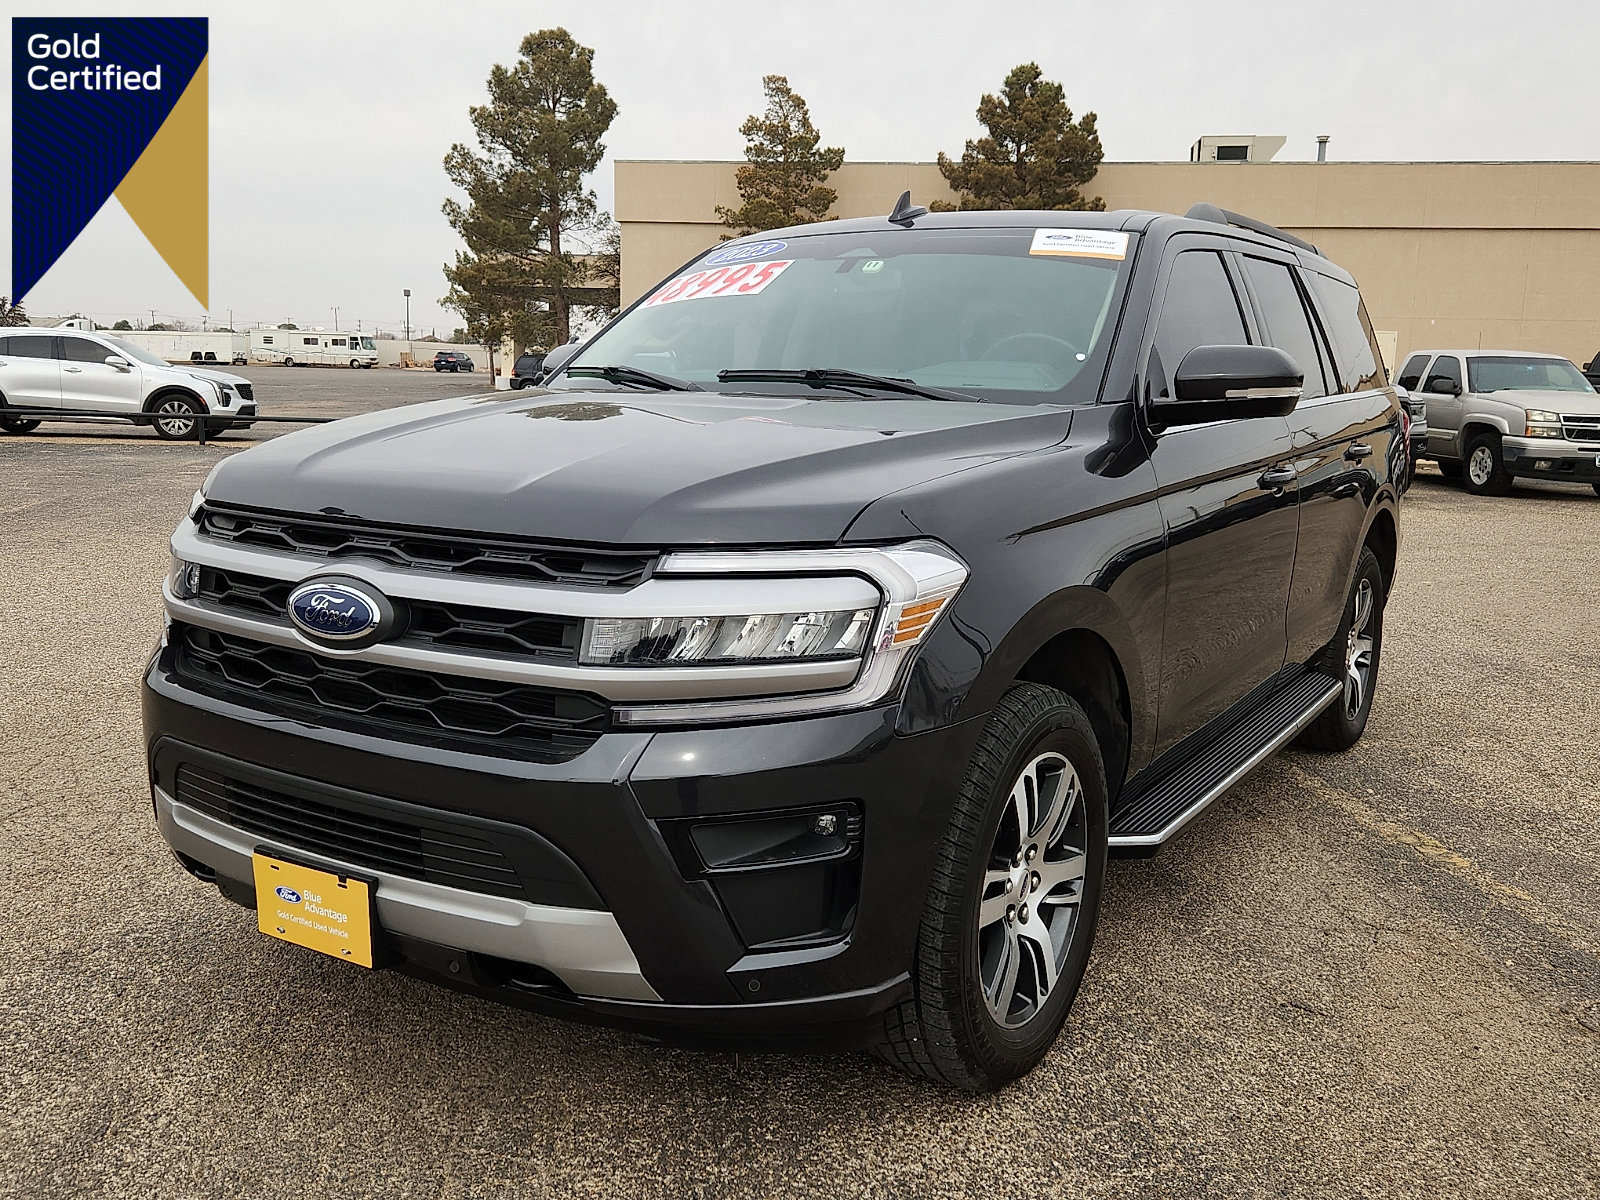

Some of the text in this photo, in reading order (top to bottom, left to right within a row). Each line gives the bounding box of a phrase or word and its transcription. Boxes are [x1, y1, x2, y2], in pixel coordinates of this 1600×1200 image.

[646, 261, 790, 307] 48995
[304, 593, 356, 628] Ford
[279, 888, 298, 903] Ford
[303, 889, 322, 904] Blue
[277, 909, 349, 939] Gold Certified Used Vehicle
[304, 902, 348, 923] Advantage
